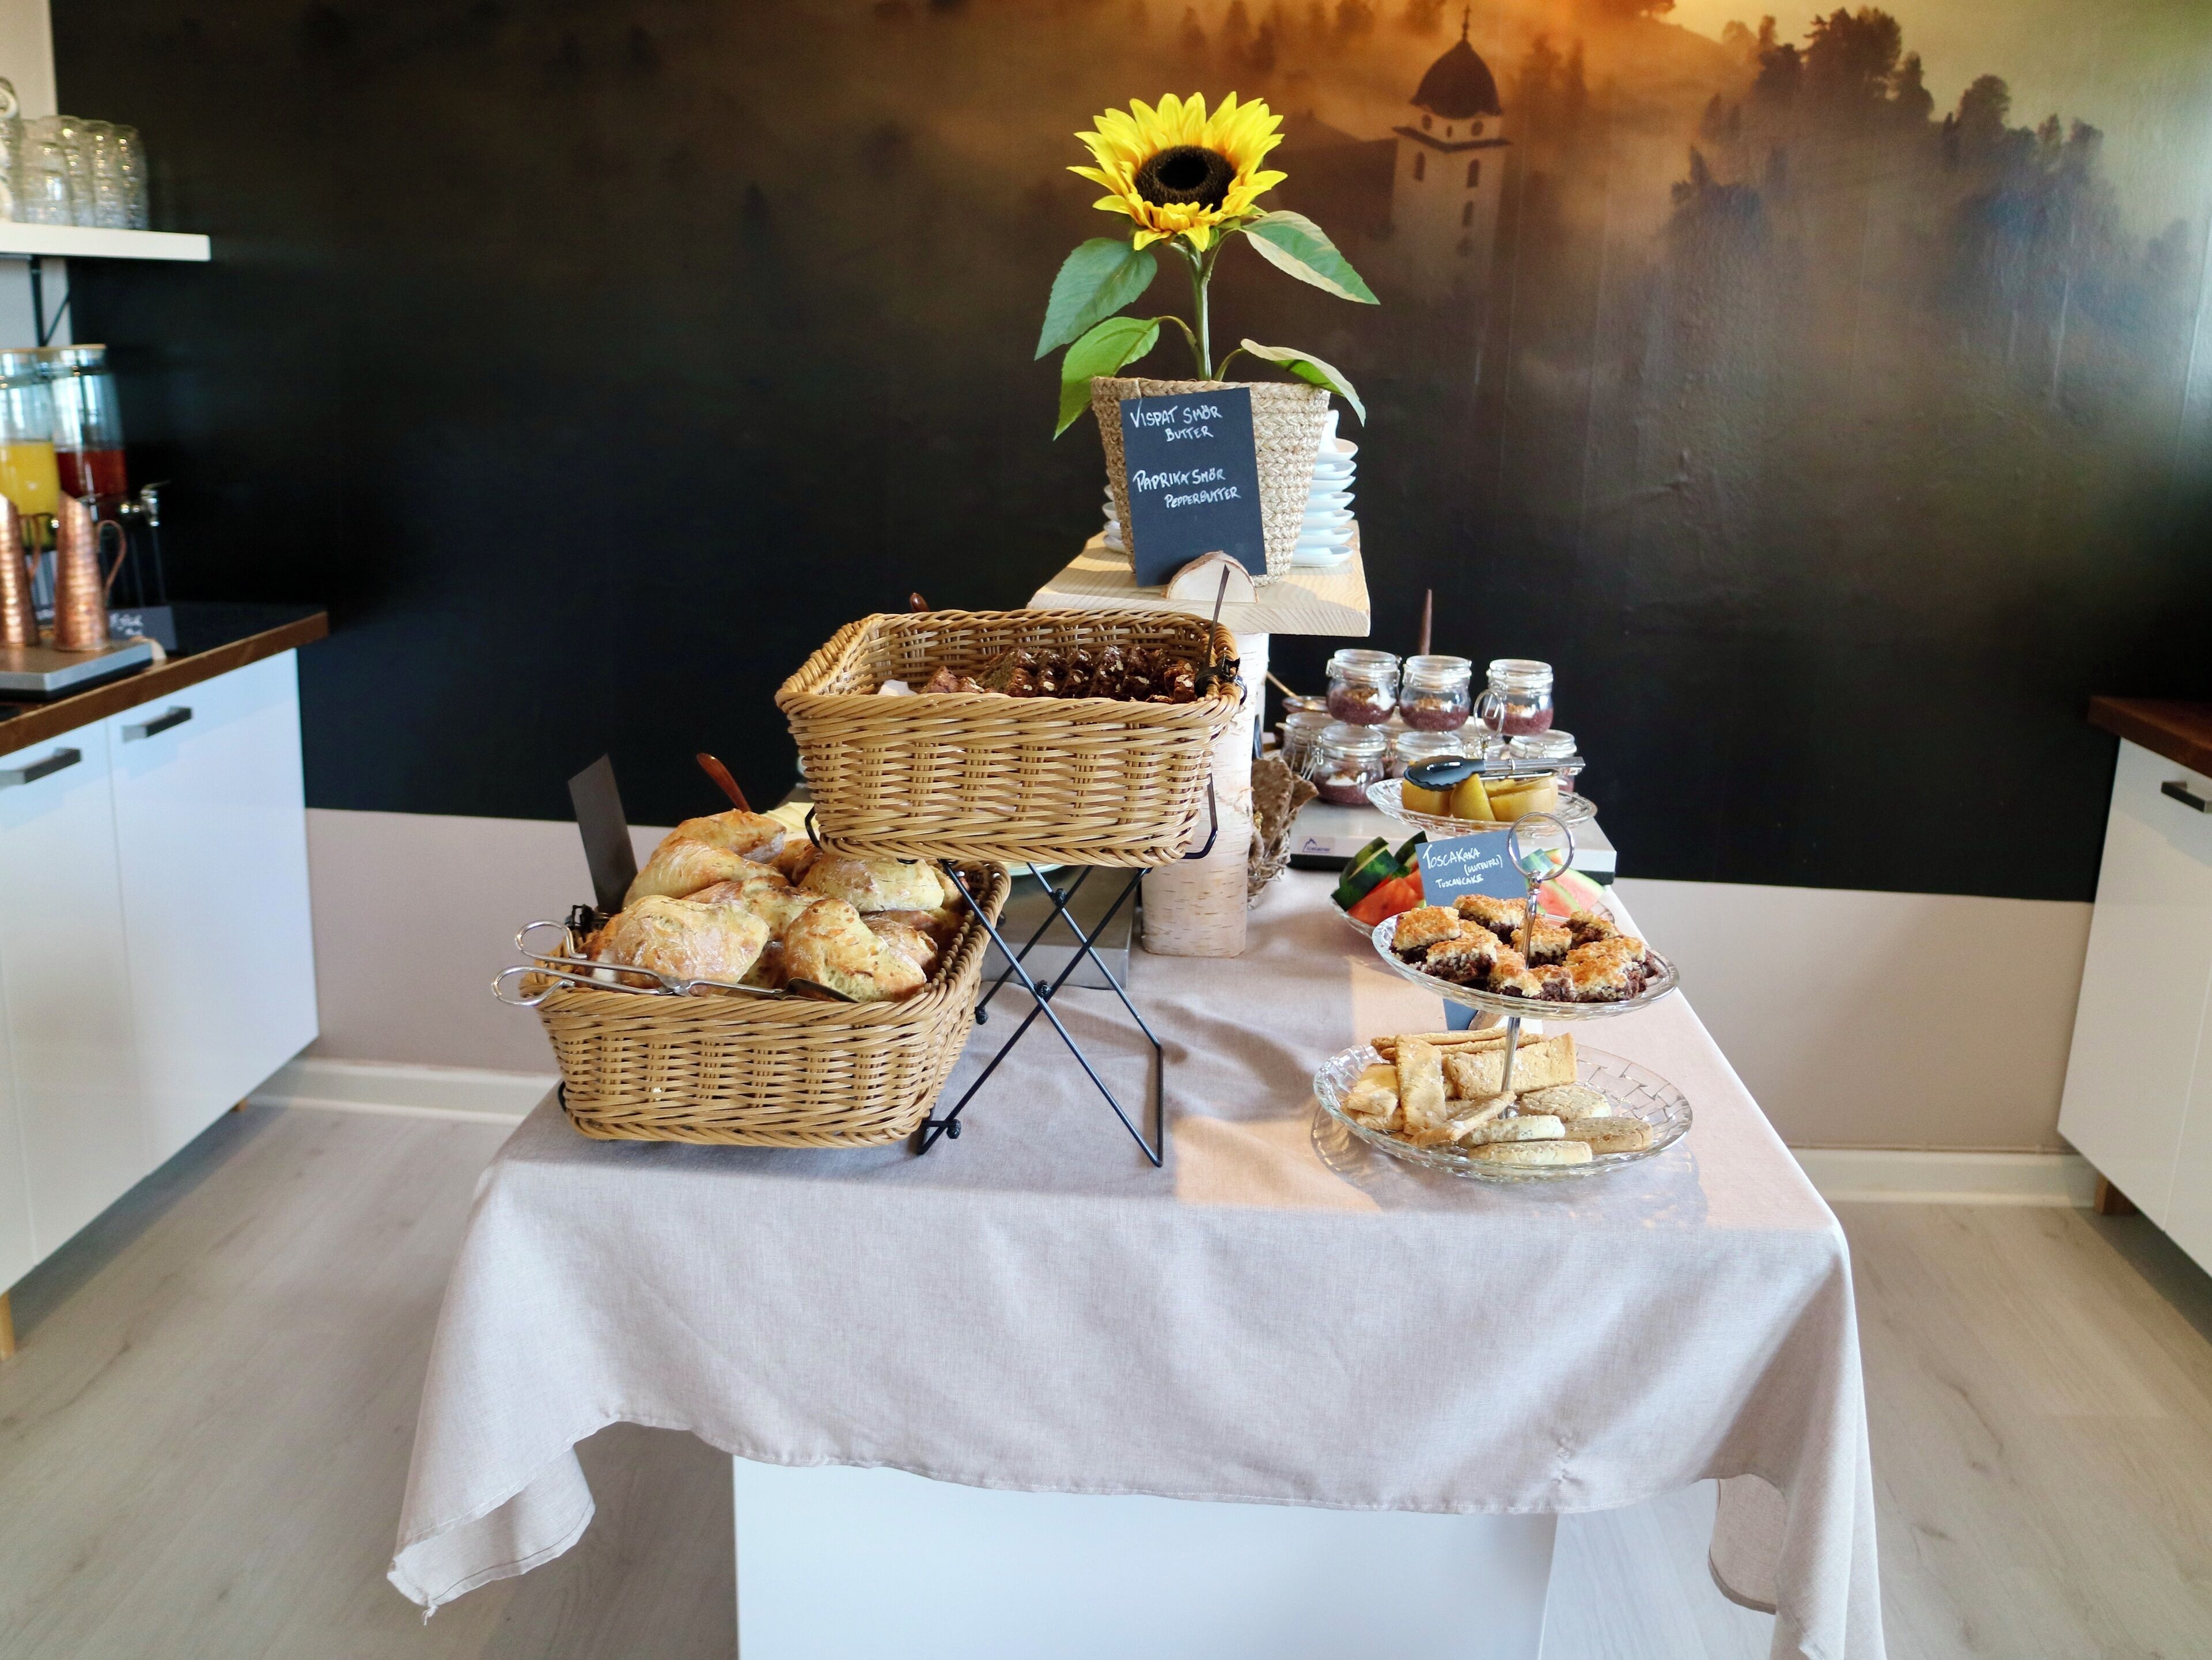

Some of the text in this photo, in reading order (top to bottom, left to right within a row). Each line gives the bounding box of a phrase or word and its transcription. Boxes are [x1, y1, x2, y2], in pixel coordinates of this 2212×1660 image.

[1130, 402, 1222, 428] VISPAT SMÖR
[1165, 425, 1214, 442] BUTTER
[1132, 467, 1226, 492] PAPRIKA SMÖR
